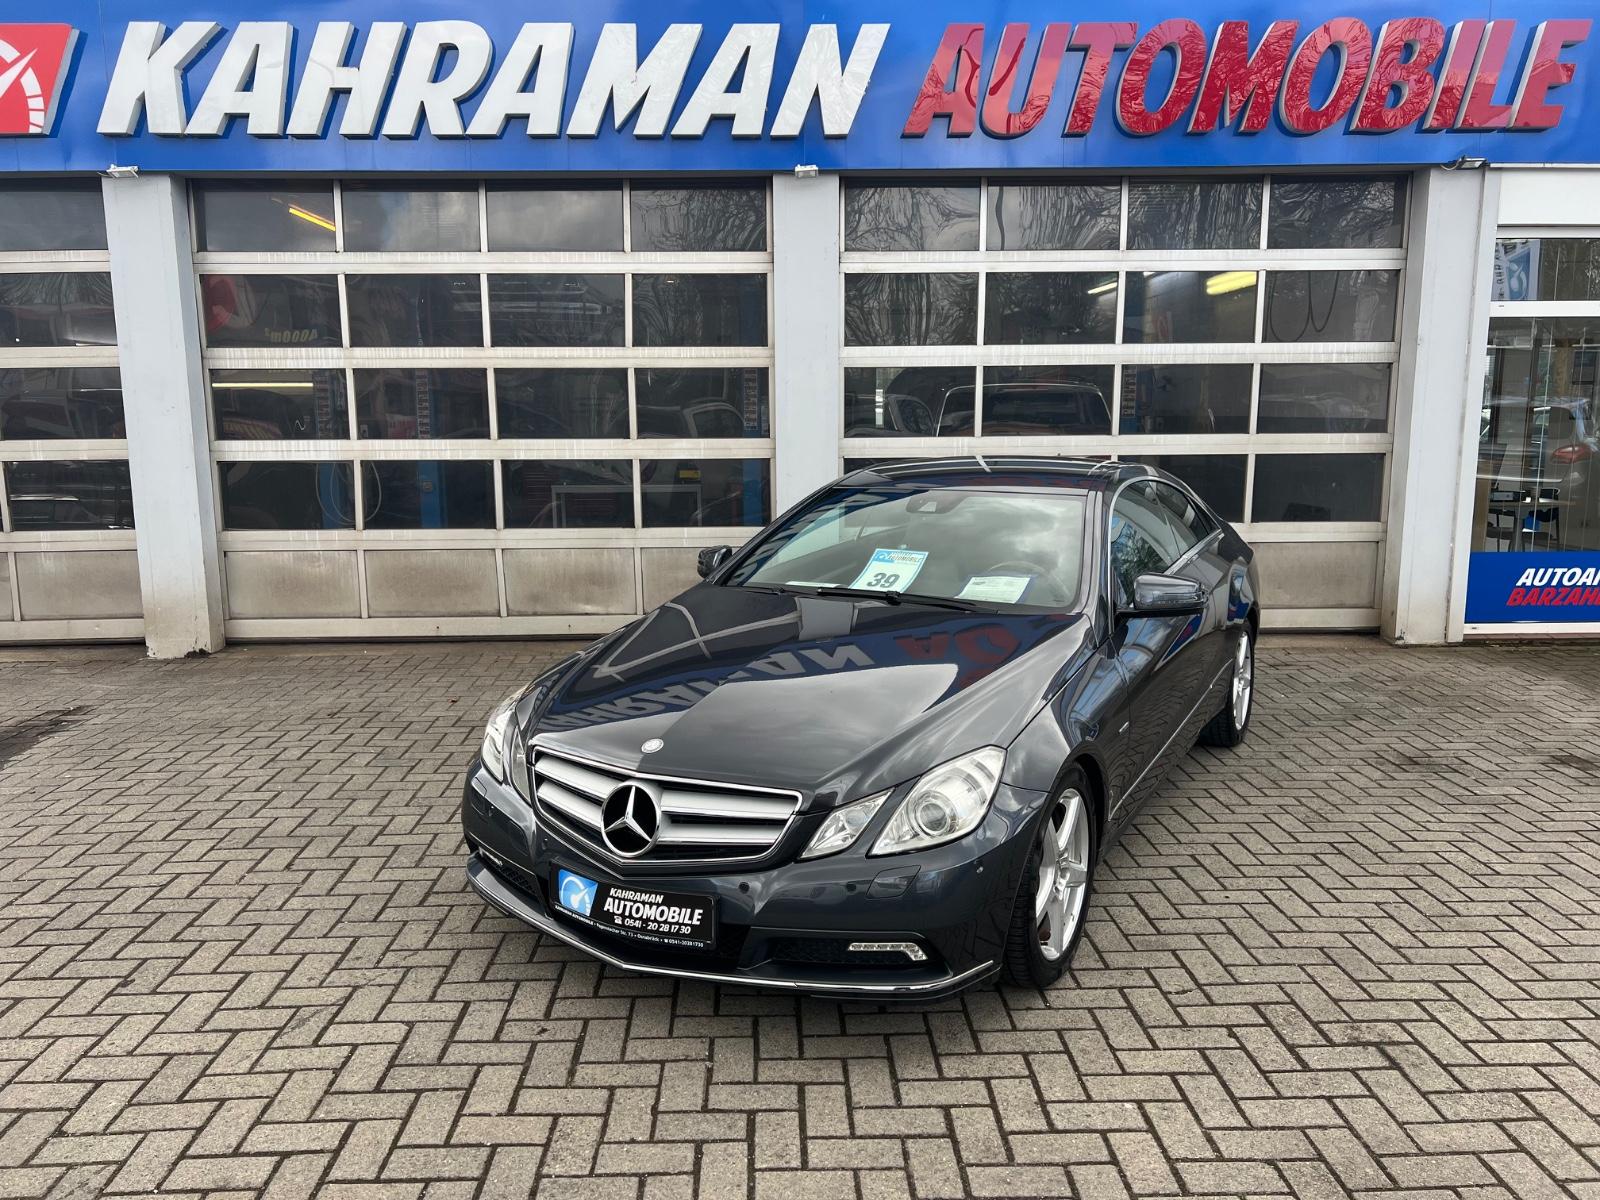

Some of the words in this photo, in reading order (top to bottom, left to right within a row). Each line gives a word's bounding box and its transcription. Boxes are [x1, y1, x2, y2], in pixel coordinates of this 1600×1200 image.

[97, 21, 891, 138] KAHRAMAN
[901, 18, 1593, 138] AUTOMOBILE
[867, 572, 900, 588] 39
[609, 887, 664, 904] KAHRAMAN
[603, 897, 704, 925] AUTOMOBILE
[624, 918, 642, 929] 0541
[647, 921, 659, 931] 20
[660, 923, 670, 933] 28
[670, 925, 680, 933] 17
[680, 926, 692, 935] 30
